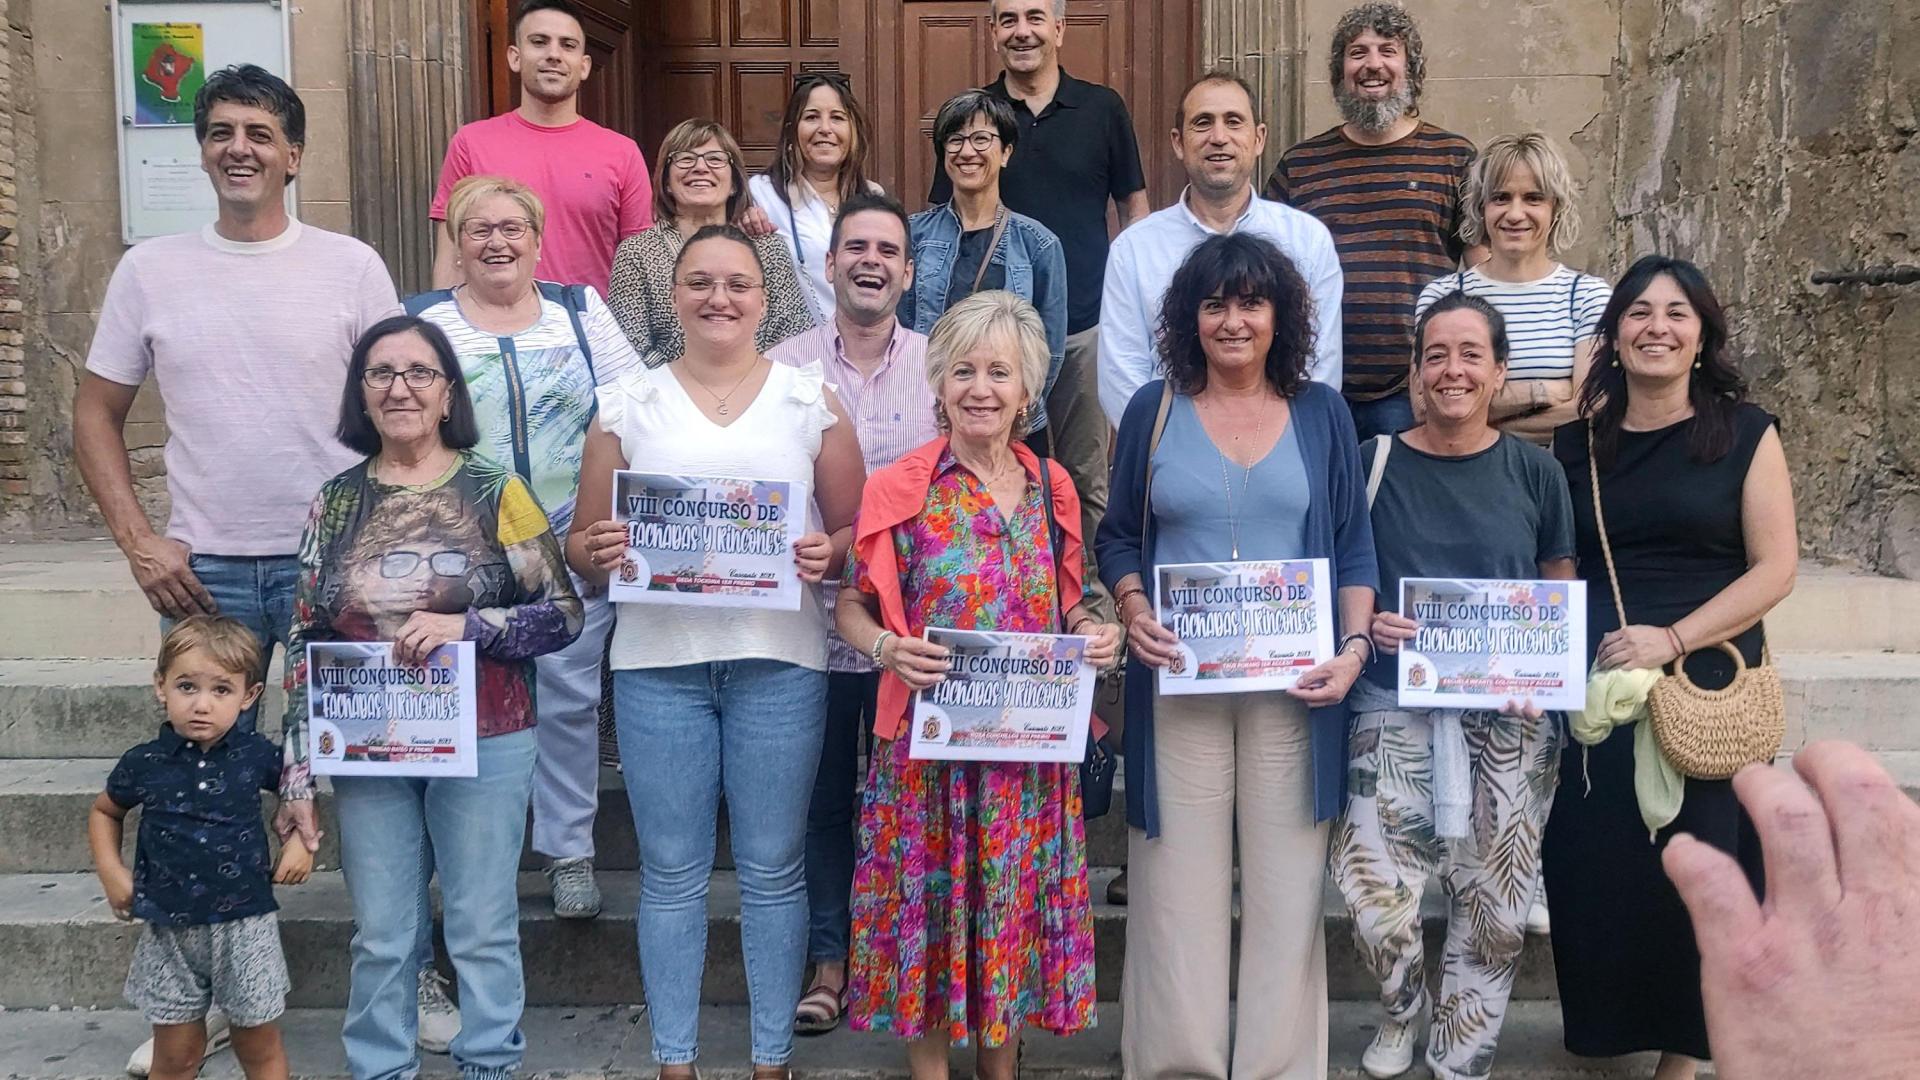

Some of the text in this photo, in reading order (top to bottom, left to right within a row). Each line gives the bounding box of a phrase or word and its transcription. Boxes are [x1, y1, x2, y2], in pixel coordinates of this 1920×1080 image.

[629, 496, 779, 521] VIII CONCURSO DE
[1171, 584, 1307, 606] VIII CONCURSO DE
[1415, 603, 1560, 621] VIII CONCURSO DE
[969, 656, 1050, 676] CONCURSO
[1053, 660, 1074, 676] DE
[320, 667, 451, 686] VIII CONCURSO DE
